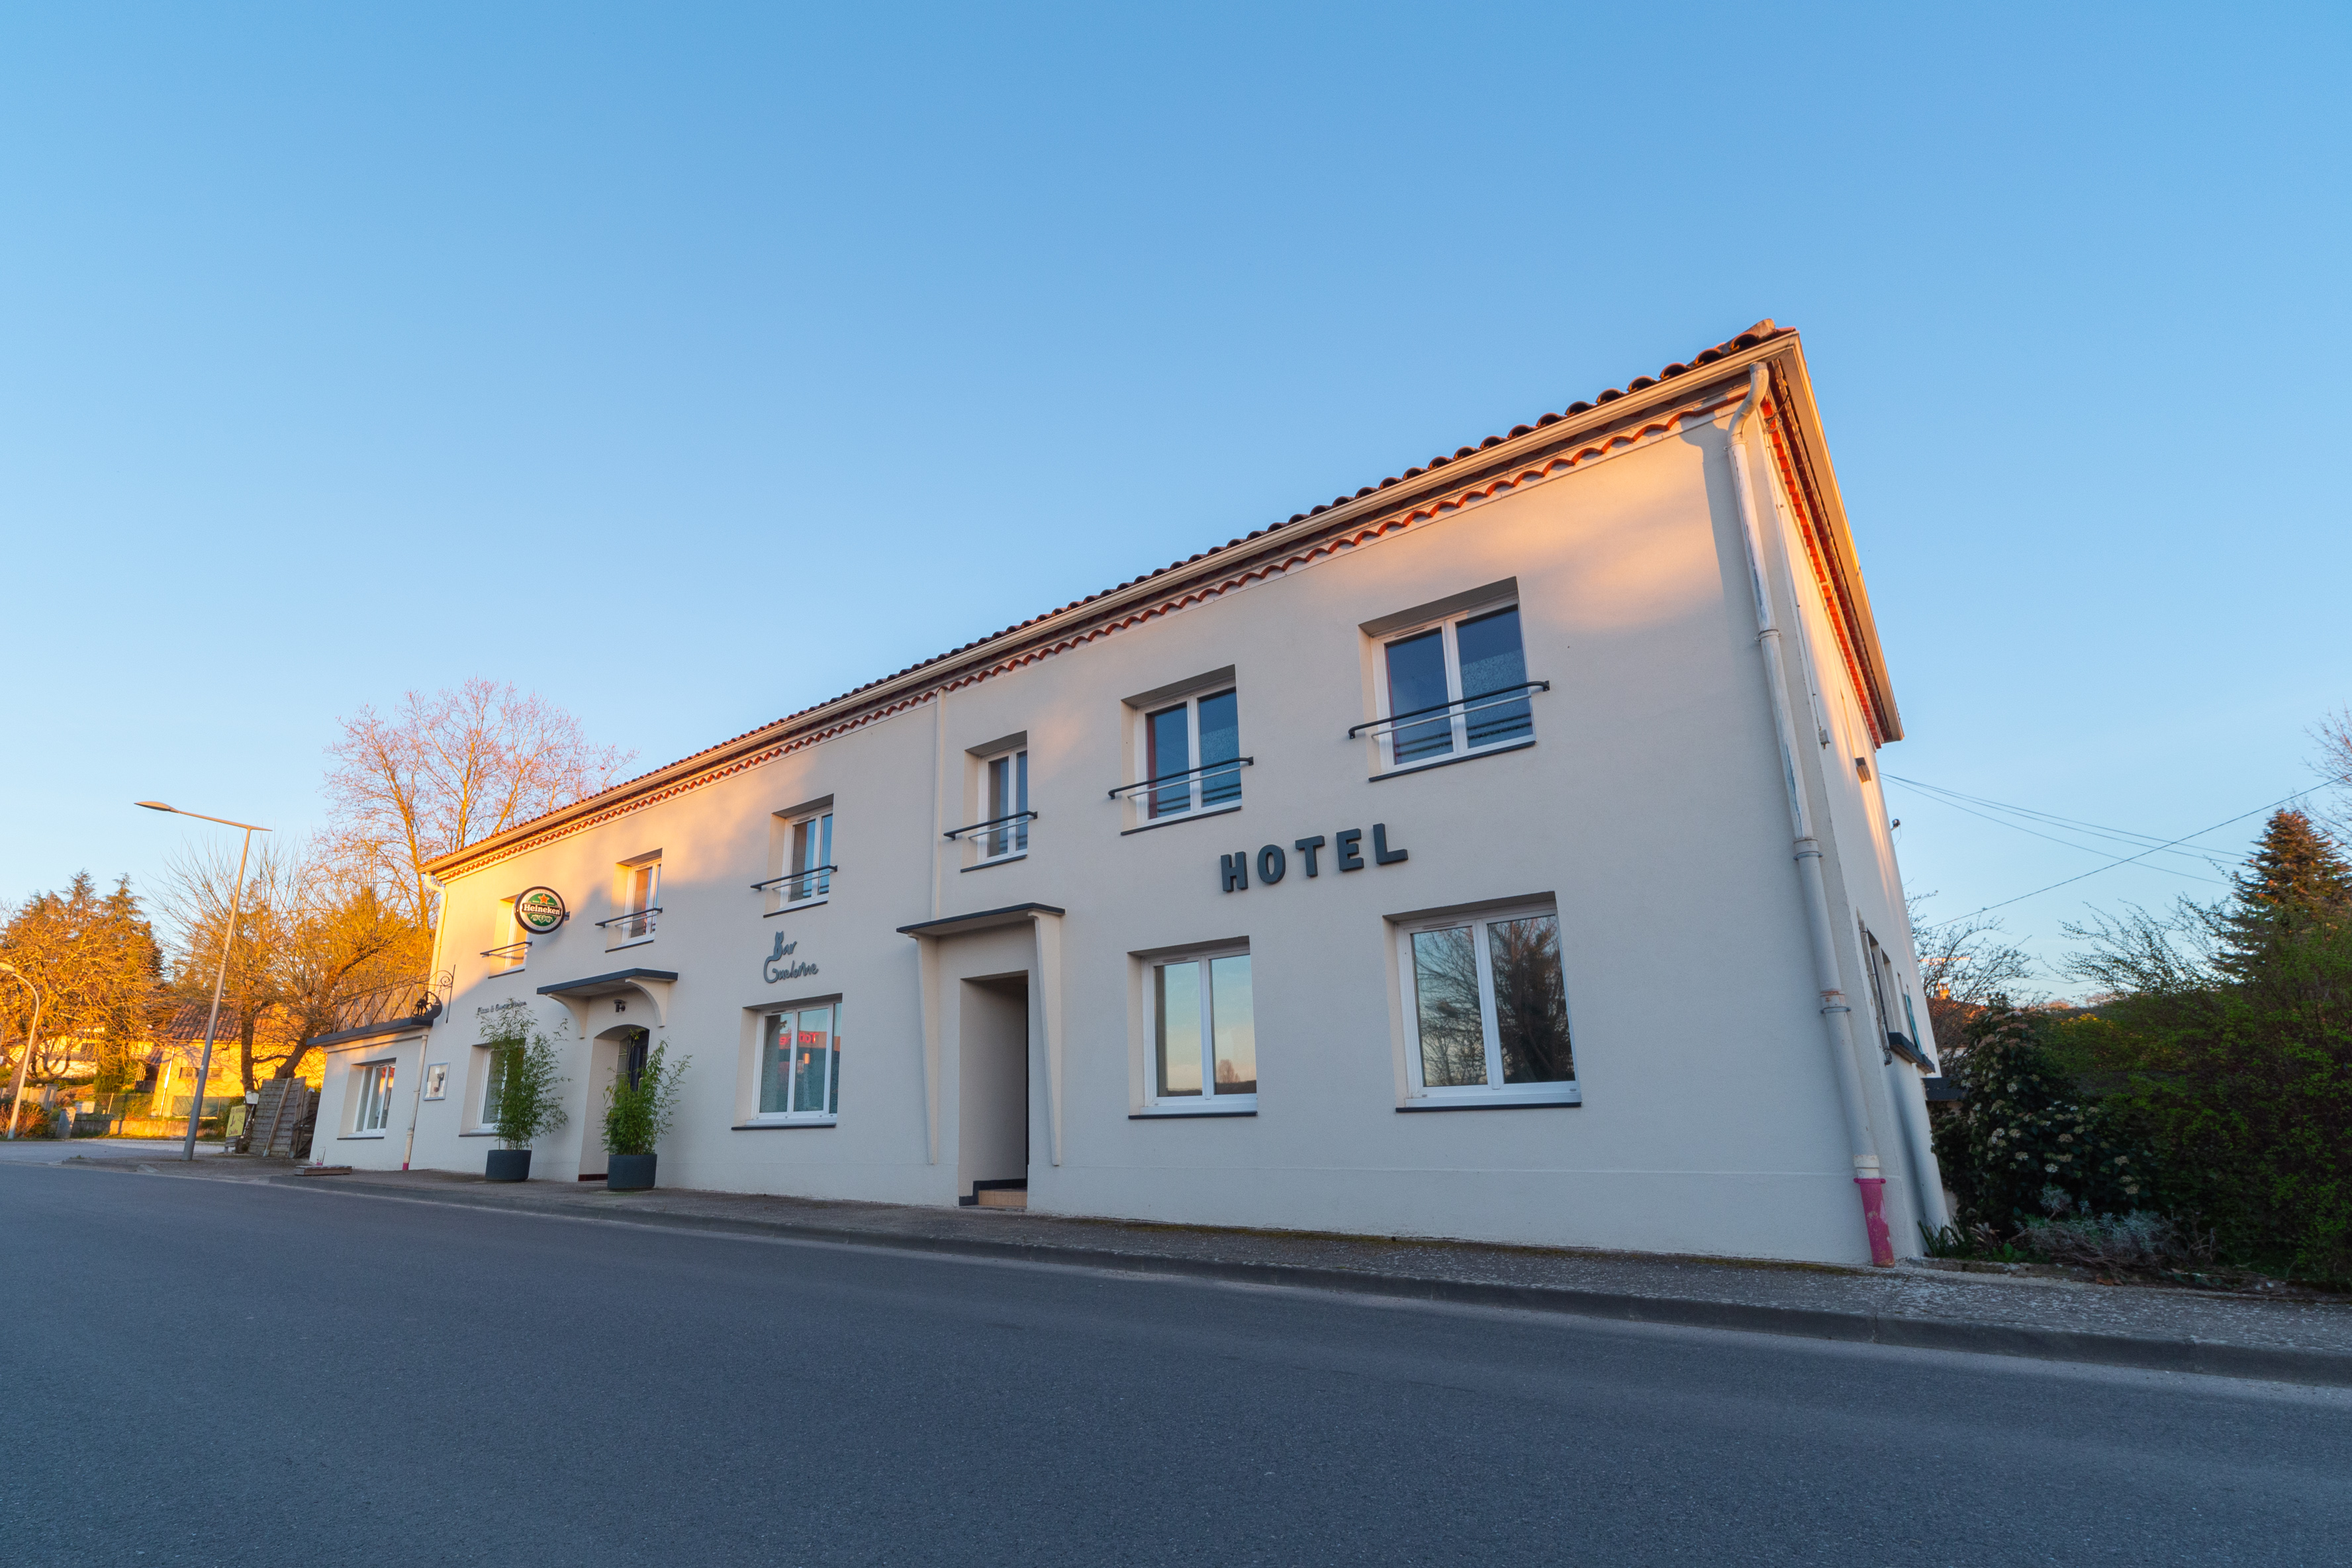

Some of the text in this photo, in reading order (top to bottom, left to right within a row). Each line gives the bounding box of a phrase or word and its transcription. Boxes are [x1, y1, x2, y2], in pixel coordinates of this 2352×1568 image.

[1220, 823, 1409, 892] HOTEL
[523, 903, 561, 915] Heineken
[773, 931, 798, 959] Bar
